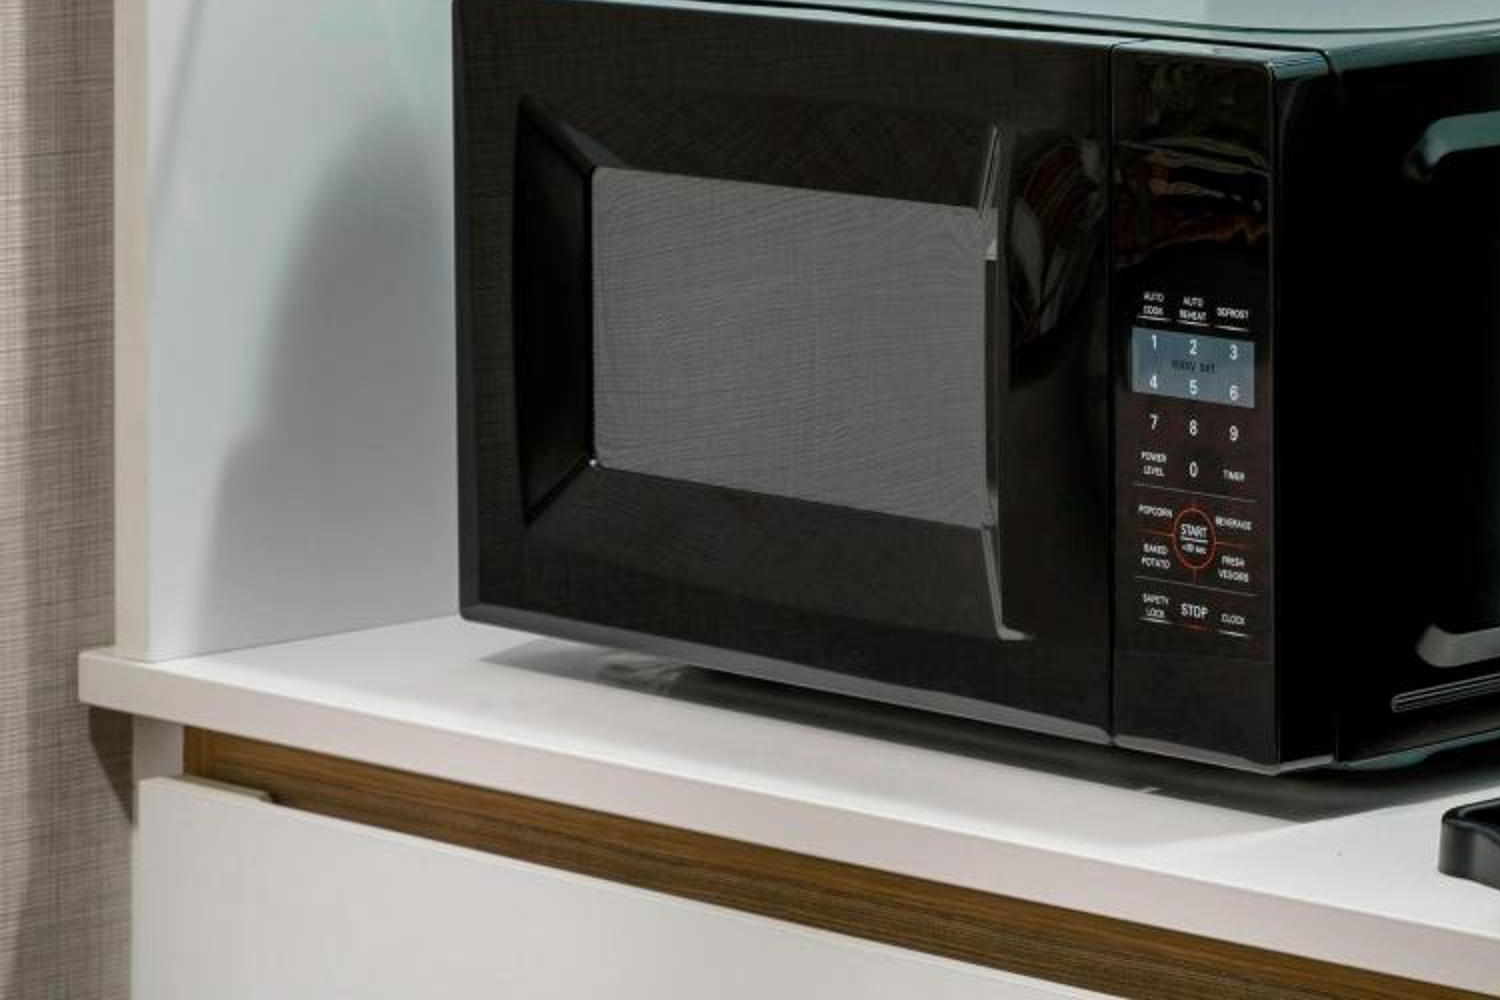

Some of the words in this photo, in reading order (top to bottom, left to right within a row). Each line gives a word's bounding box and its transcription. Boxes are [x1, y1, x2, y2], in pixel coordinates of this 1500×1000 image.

[1143, 291, 1165, 302] AUTO
[1183, 297, 1204, 308] AUTO
[1143, 305, 1164, 316] COOK
[1179, 309, 1207, 321] REHEAT
[1216, 307, 1249, 319] DEFROST
[1151, 334, 1157, 350] 1
[1189, 339, 1198, 355] 2
[1229, 344, 1239, 360] 3
[1149, 375, 1158, 389] 4
[1189, 379, 1198, 395] 5
[1229, 385, 1239, 401] 6
[1149, 413, 1158, 430] 7
[1189, 419, 1198, 436] 8
[1229, 425, 1239, 441] 9
[1141, 451, 1167, 463] POWER
[1143, 465, 1165, 477] LEVEL
[1189, 461, 1198, 478] 0
[1223, 469, 1245, 482] TIMER
[1138, 504, 1173, 518] POPCORN
[1181, 523, 1207, 538] START
[1215, 516, 1252, 531] BEVERAGE
[1143, 543, 1169, 555] BAKED
[1141, 556, 1171, 570] POTATO
[1222, 555, 1245, 567] FRESH
[1143, 593, 1169, 605] SAFETY
[1145, 607, 1165, 618] LOCK
[1181, 603, 1209, 619] STOP
[1221, 613, 1246, 625] CLOCK
